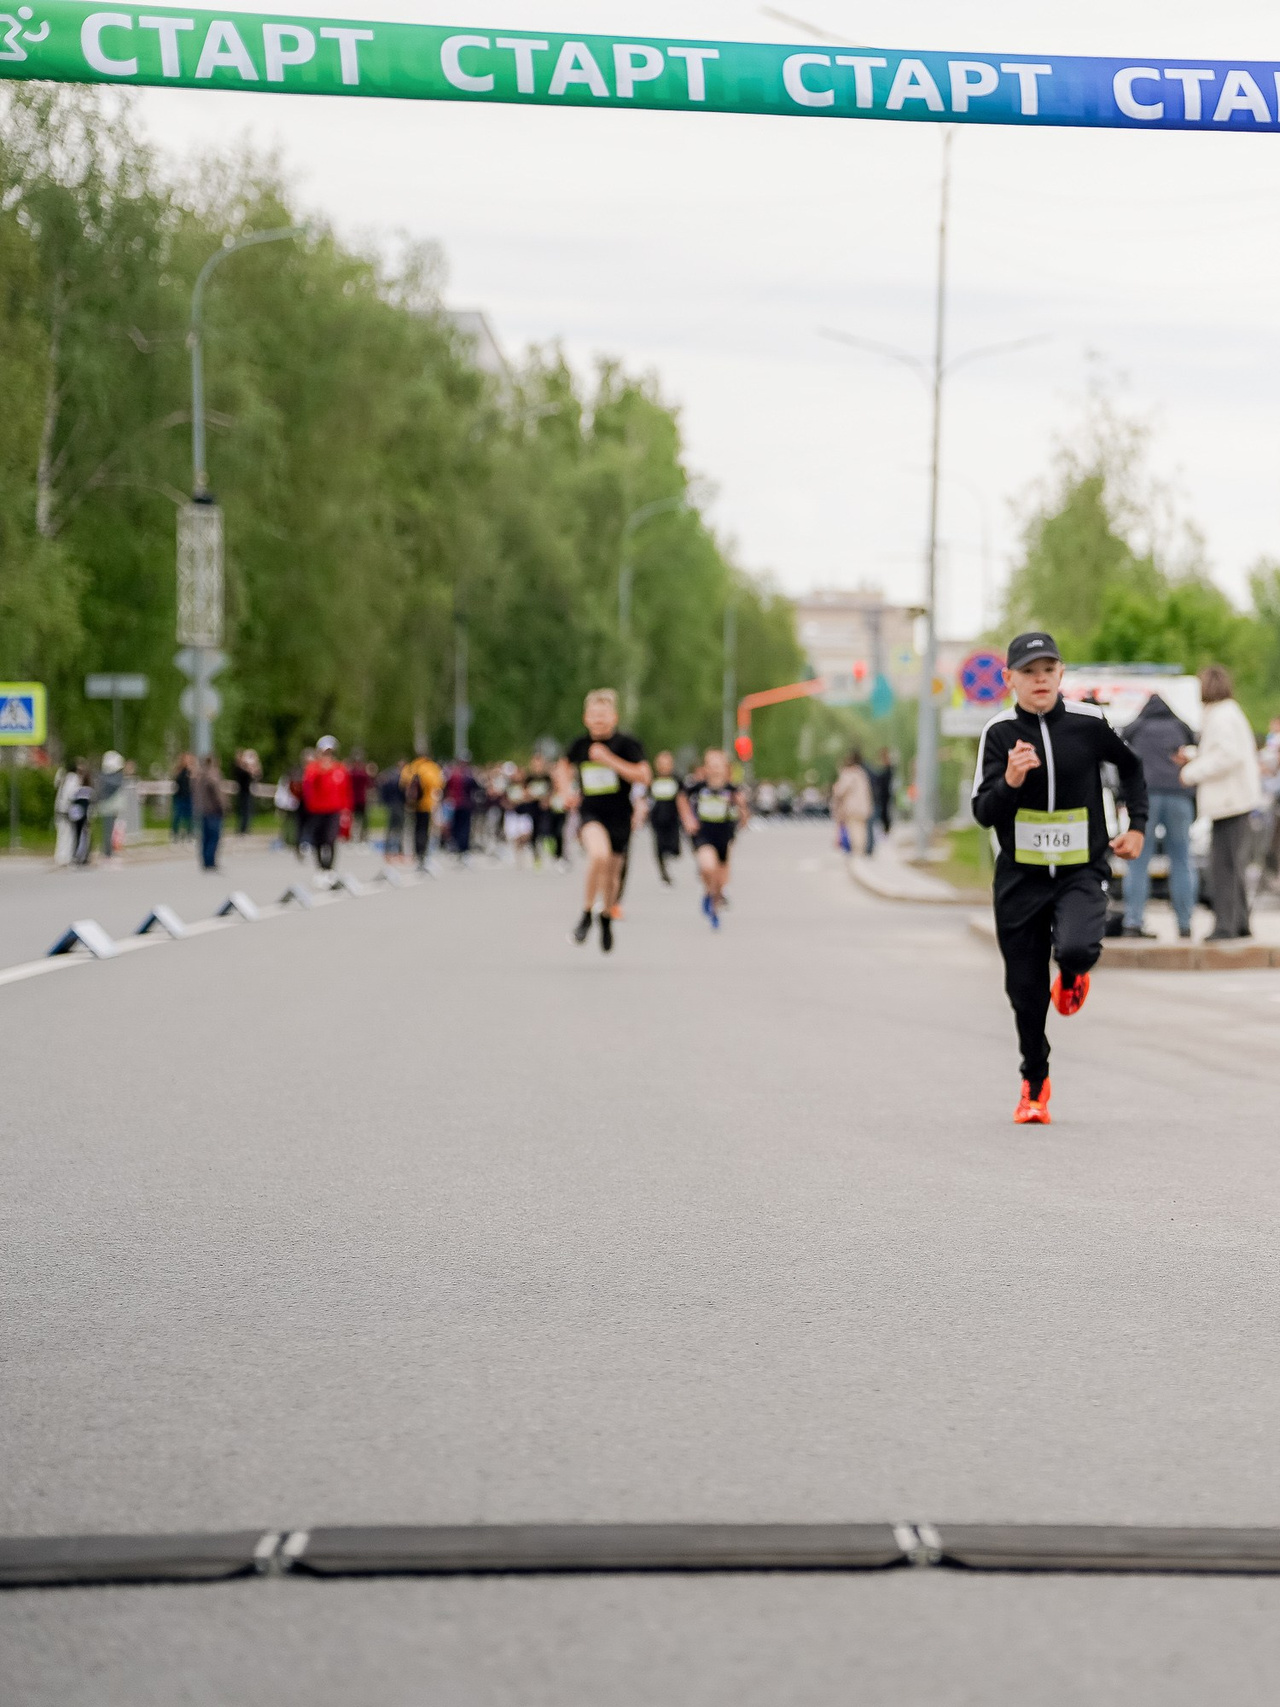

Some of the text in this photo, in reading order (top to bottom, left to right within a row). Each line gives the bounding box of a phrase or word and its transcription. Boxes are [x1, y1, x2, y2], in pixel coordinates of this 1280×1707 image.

[81, 12, 374, 84] СТАРТ
[441, 35, 719, 100] СТАРТ
[783, 54, 1052, 114] СТАРТ
[1033, 833, 1070, 848] 3168
